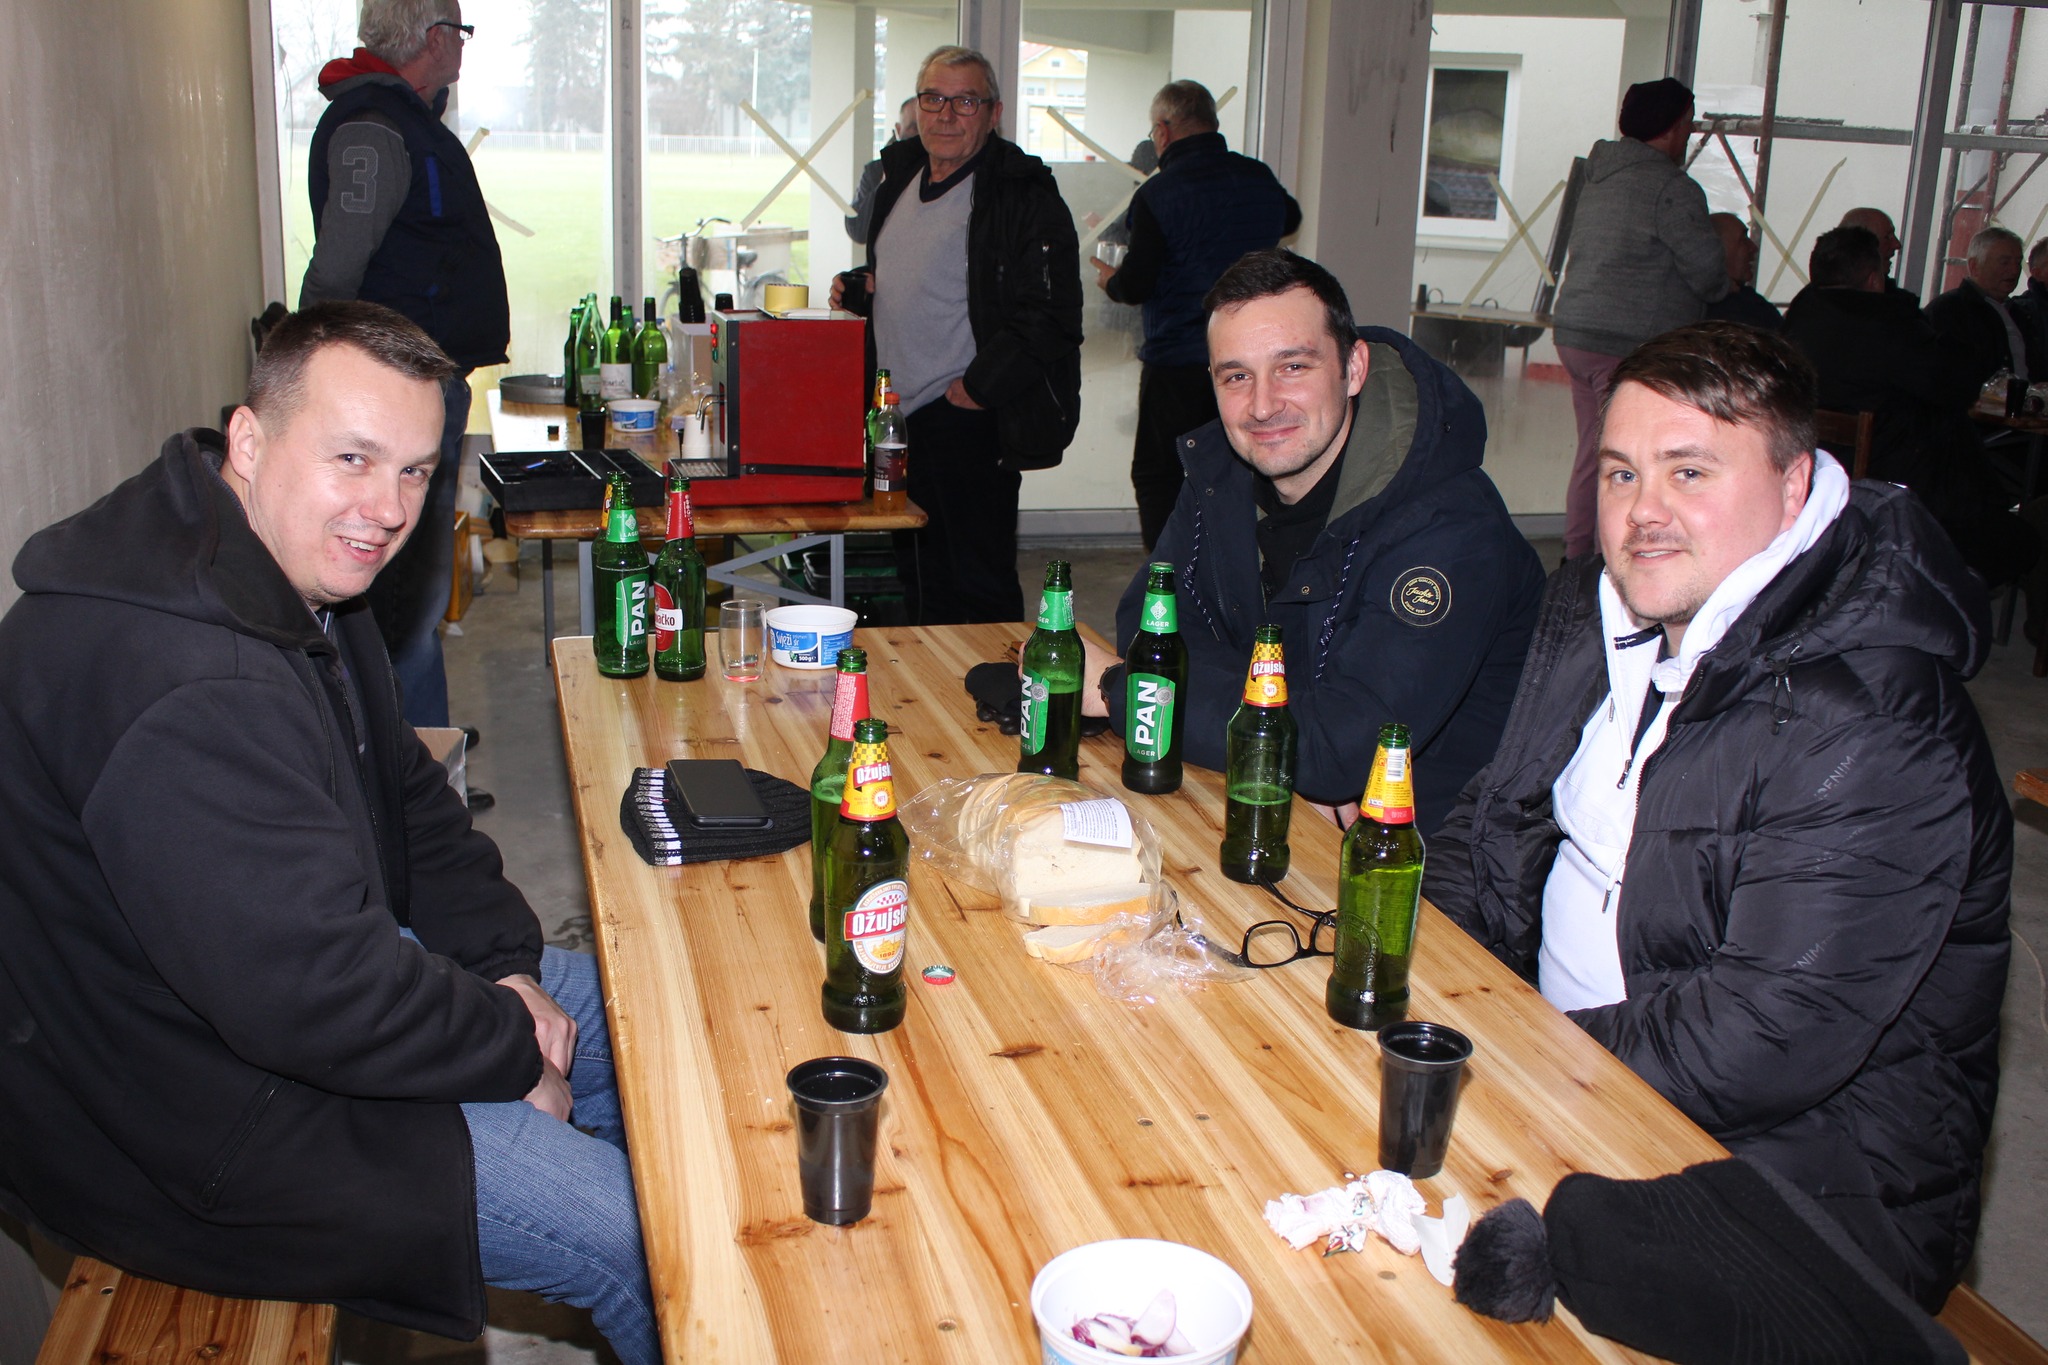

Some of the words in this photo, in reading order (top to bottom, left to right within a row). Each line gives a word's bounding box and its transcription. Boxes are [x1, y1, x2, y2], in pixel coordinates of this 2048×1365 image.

[341, 146, 379, 213] 3
[631, 580, 646, 637] PAN
[1146, 619, 1170, 628] LAGER
[1020, 673, 1033, 739] PAN
[1134, 680, 1158, 746] PAN
[856, 763, 892, 785] Ožujsk
[852, 903, 908, 936] Ožujsk
